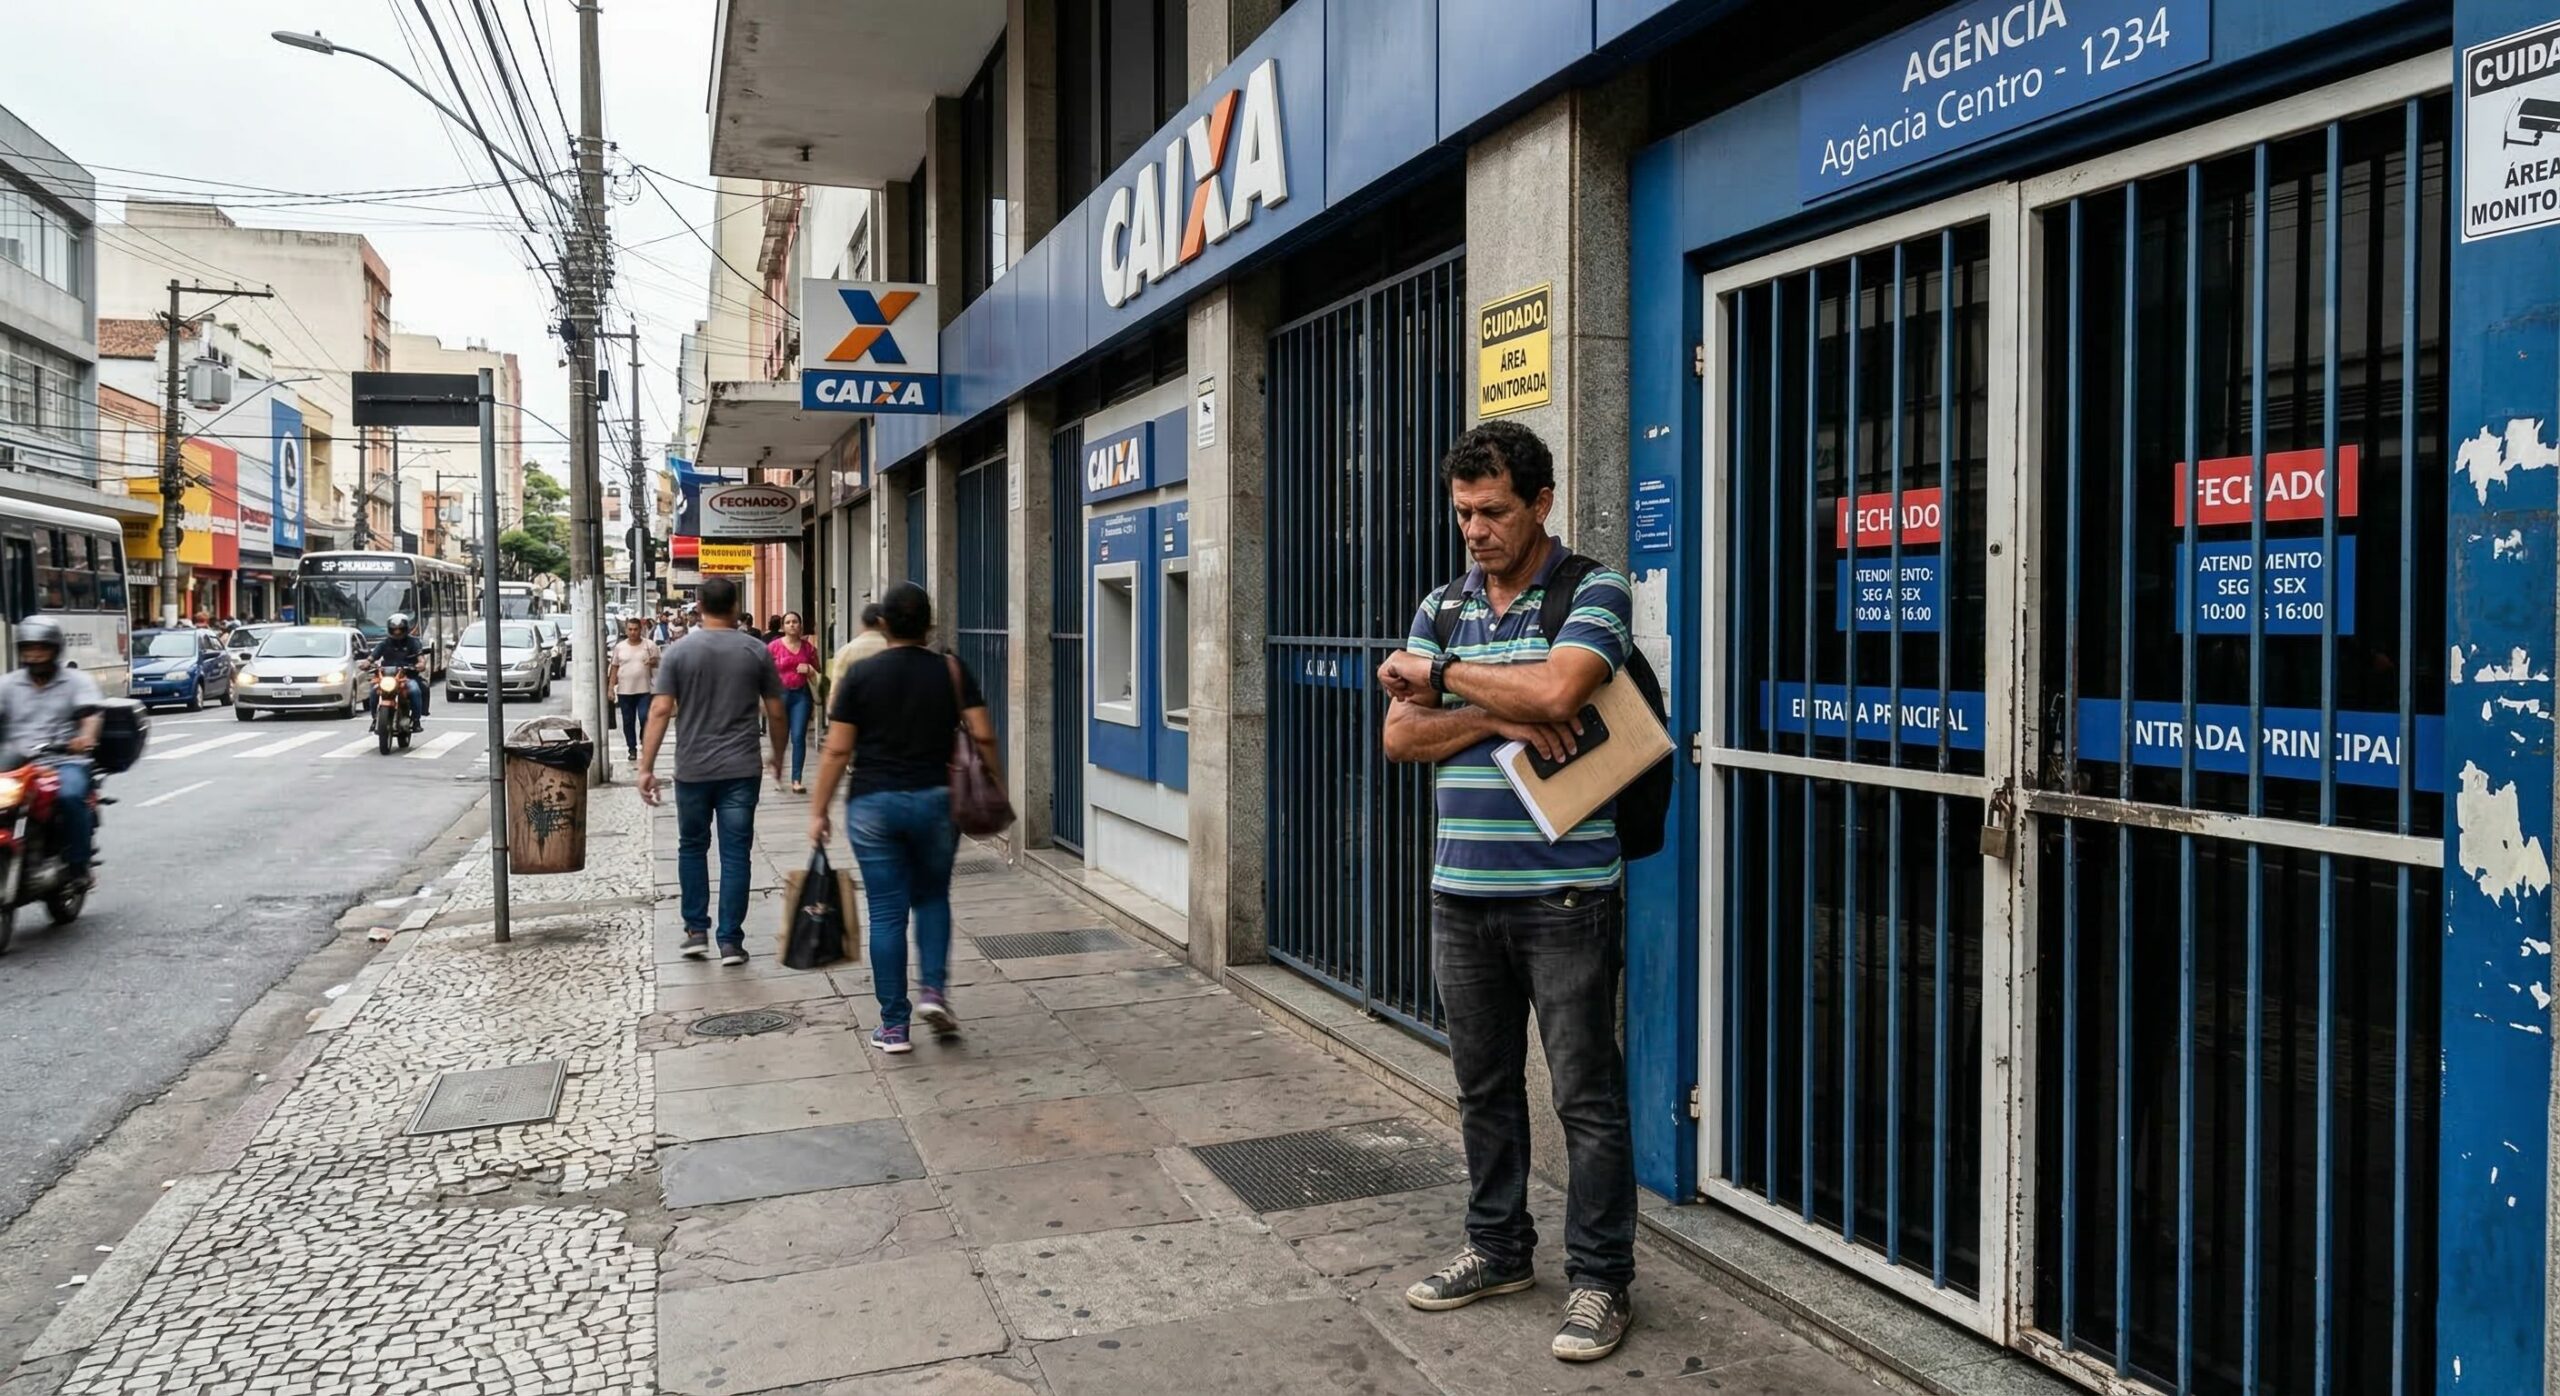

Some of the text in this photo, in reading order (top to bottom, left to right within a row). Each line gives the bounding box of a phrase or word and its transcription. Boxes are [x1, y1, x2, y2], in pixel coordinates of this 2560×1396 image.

[1902, 0, 2067, 93] AGÊNCIA
[1820, 7, 2170, 176] Agência Centro - 1234
[1101, 57, 1288, 307] CAIXA
[2472, 188, 2560, 226] MONITO
[1483, 300, 1546, 340] CUIDADO,
[1501, 348, 1526, 372] ÁREA
[816, 379, 924, 405] CAIXA
[1482, 370, 1547, 405] MONITORADA
[1088, 436, 1140, 493] CAIXA
[719, 497, 788, 508] FECHADOS
[1856, 568, 1933, 582] ATENDIENTO:
[2218, 579, 2249, 595] SEG
[2273, 577, 2306, 594] SEX
[1862, 588, 1883, 602] SEG
[1901, 587, 1921, 601] SEX
[1901, 606, 1931, 621] 16:00
[2201, 603, 2246, 620] 10:00
[2275, 602, 2324, 620] 16:00
[1792, 698, 1968, 731] ETRAA PRNCIPAL
